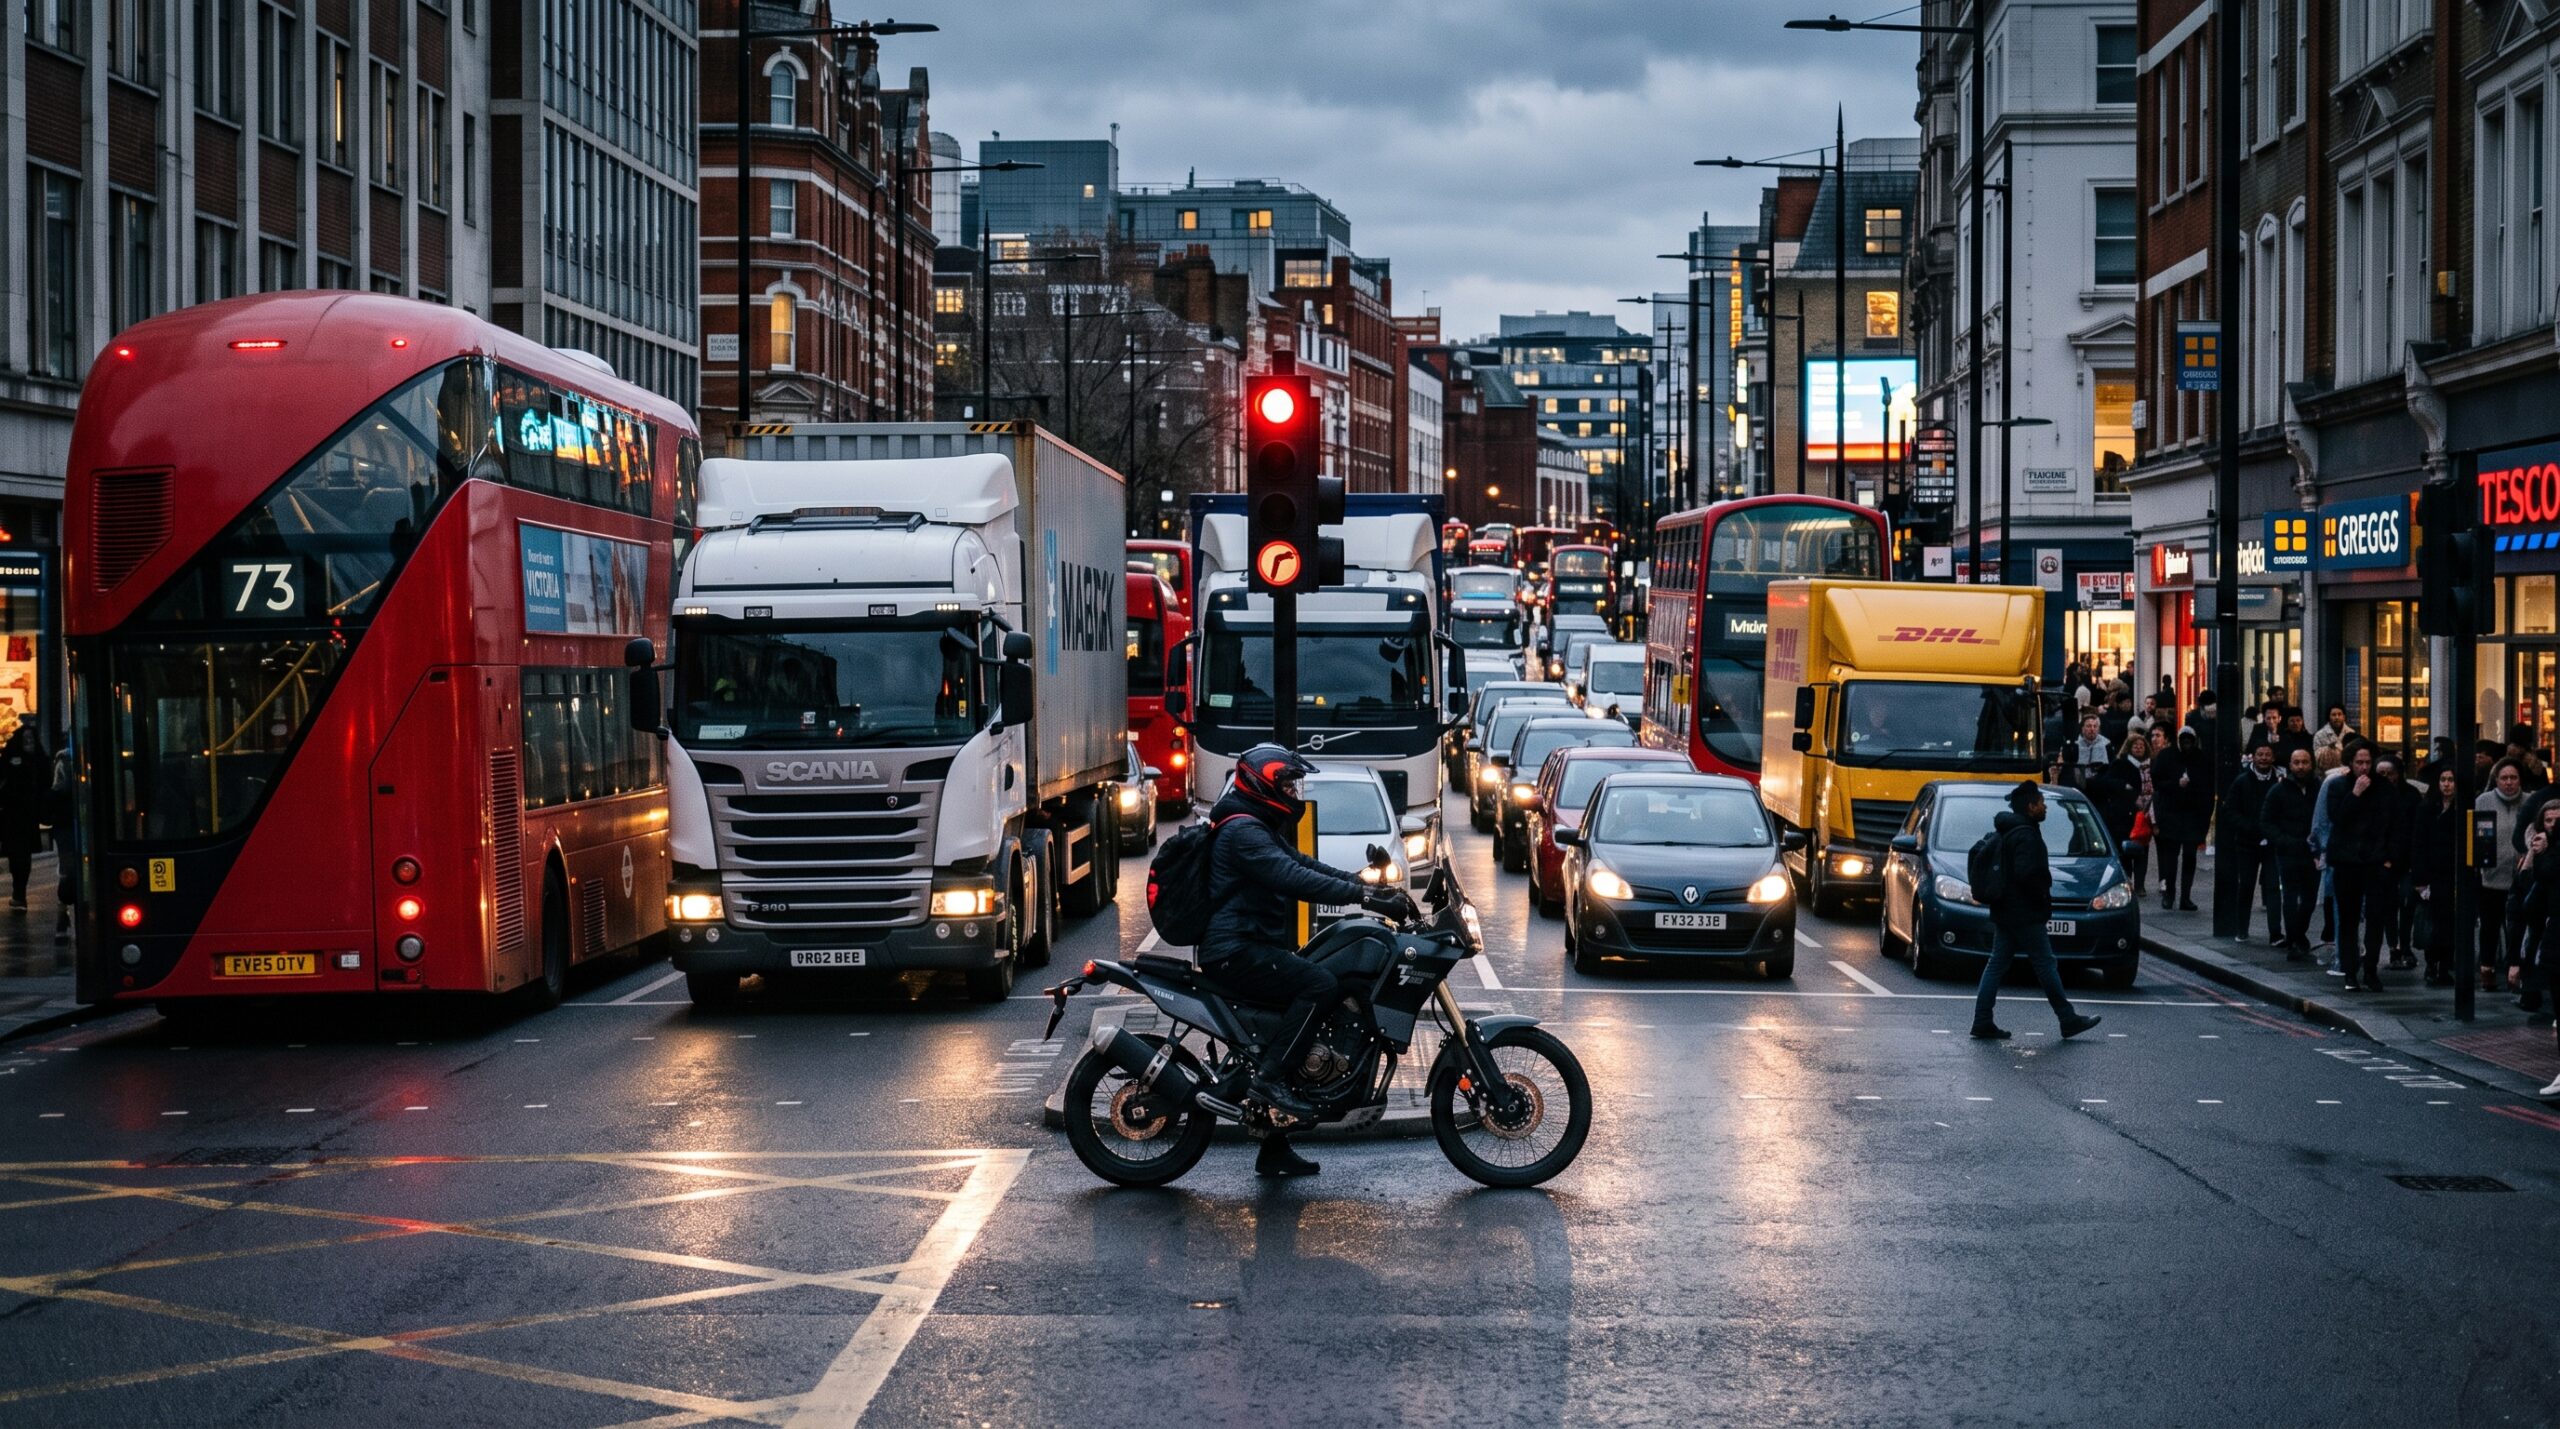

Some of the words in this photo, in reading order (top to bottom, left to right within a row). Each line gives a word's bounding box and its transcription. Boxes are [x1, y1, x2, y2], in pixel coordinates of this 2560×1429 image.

[2478, 463, 2560, 525] TESCO
[2338, 509, 2399, 556] GREGGS
[233, 564, 295, 611] 73
[1893, 627, 1985, 643] DHL
[766, 761, 879, 781] SCANIA
